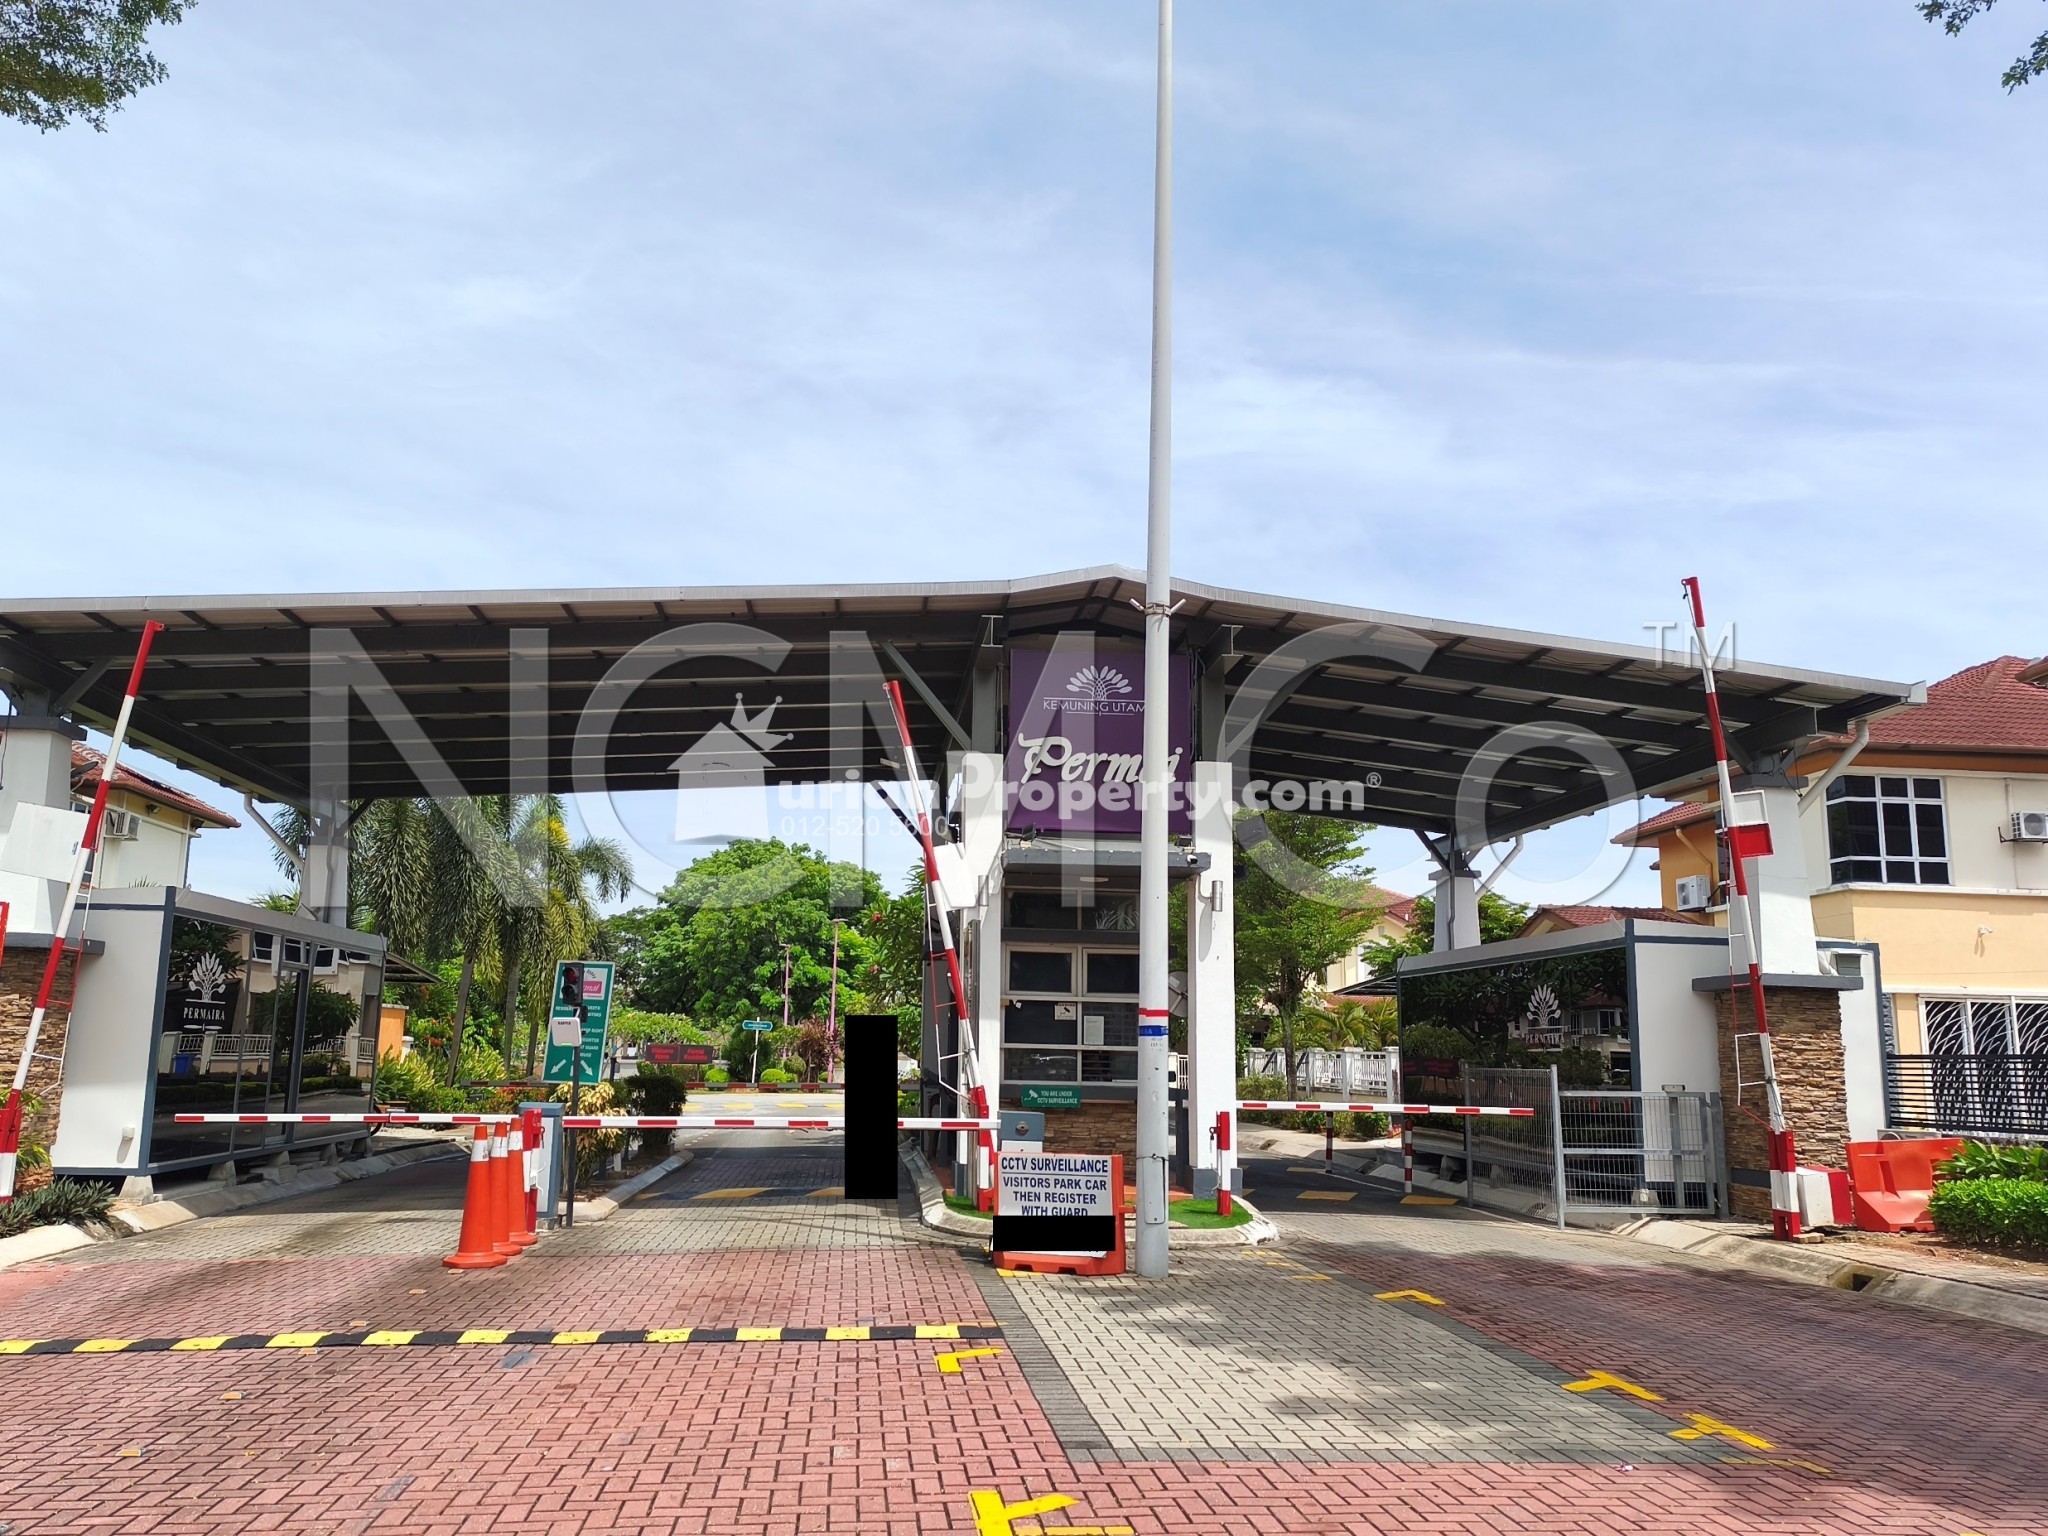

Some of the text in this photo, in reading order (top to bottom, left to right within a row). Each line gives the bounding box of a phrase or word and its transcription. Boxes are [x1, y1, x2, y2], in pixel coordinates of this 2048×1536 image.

[1043, 700, 1145, 713] KEMUNING UTAM
[1018, 732, 1183, 784] Permi
[183, 1007, 225, 1020] PERMAIRA
[1001, 1157, 1108, 1173] CCTV SURVEILLANCE
[1003, 1176, 1107, 1191] VISITORS PARK CAR
[1013, 1191, 1097, 1204] THEN REGISTER
[1021, 1205, 1088, 1216] WITH GUARD
